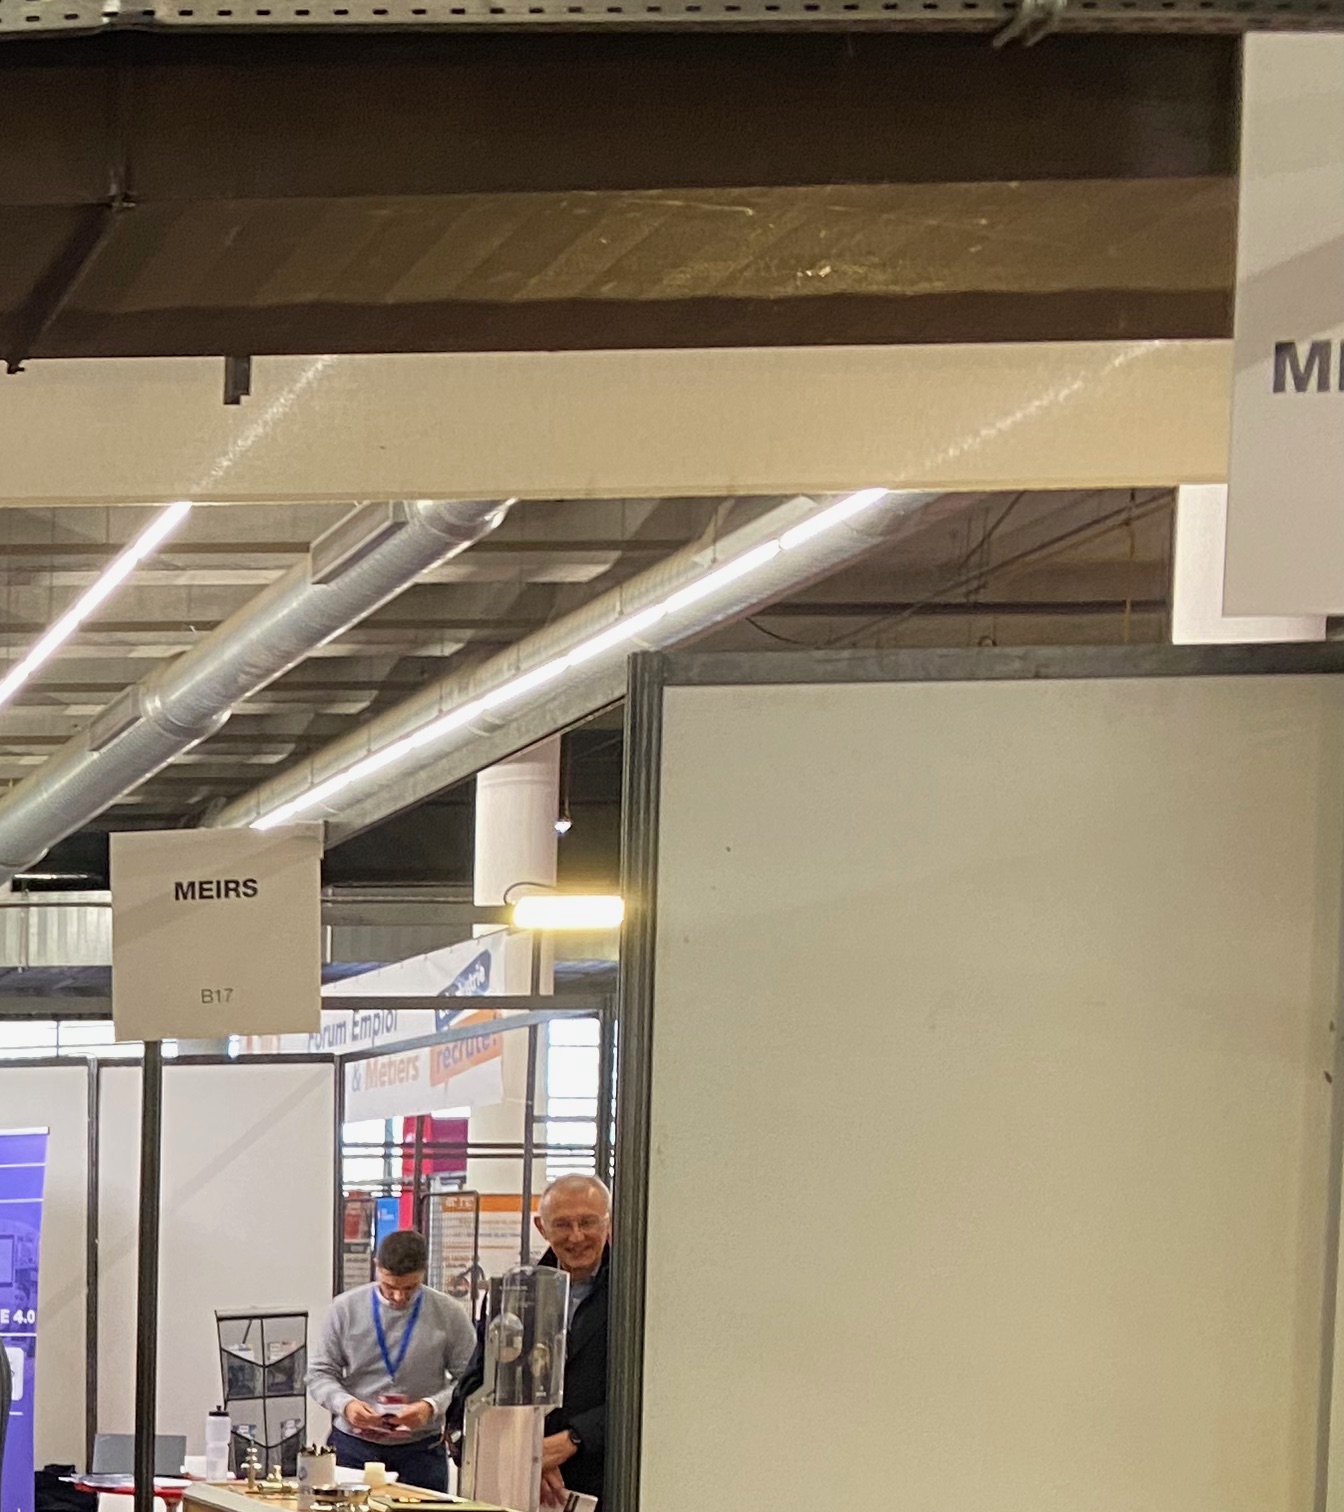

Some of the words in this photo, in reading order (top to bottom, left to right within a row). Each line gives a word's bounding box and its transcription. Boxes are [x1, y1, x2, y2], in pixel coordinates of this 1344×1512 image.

[174, 878, 258, 901] MEIRS
[201, 988, 233, 1004] B17
[13, 1309, 36, 1324] 4.0
